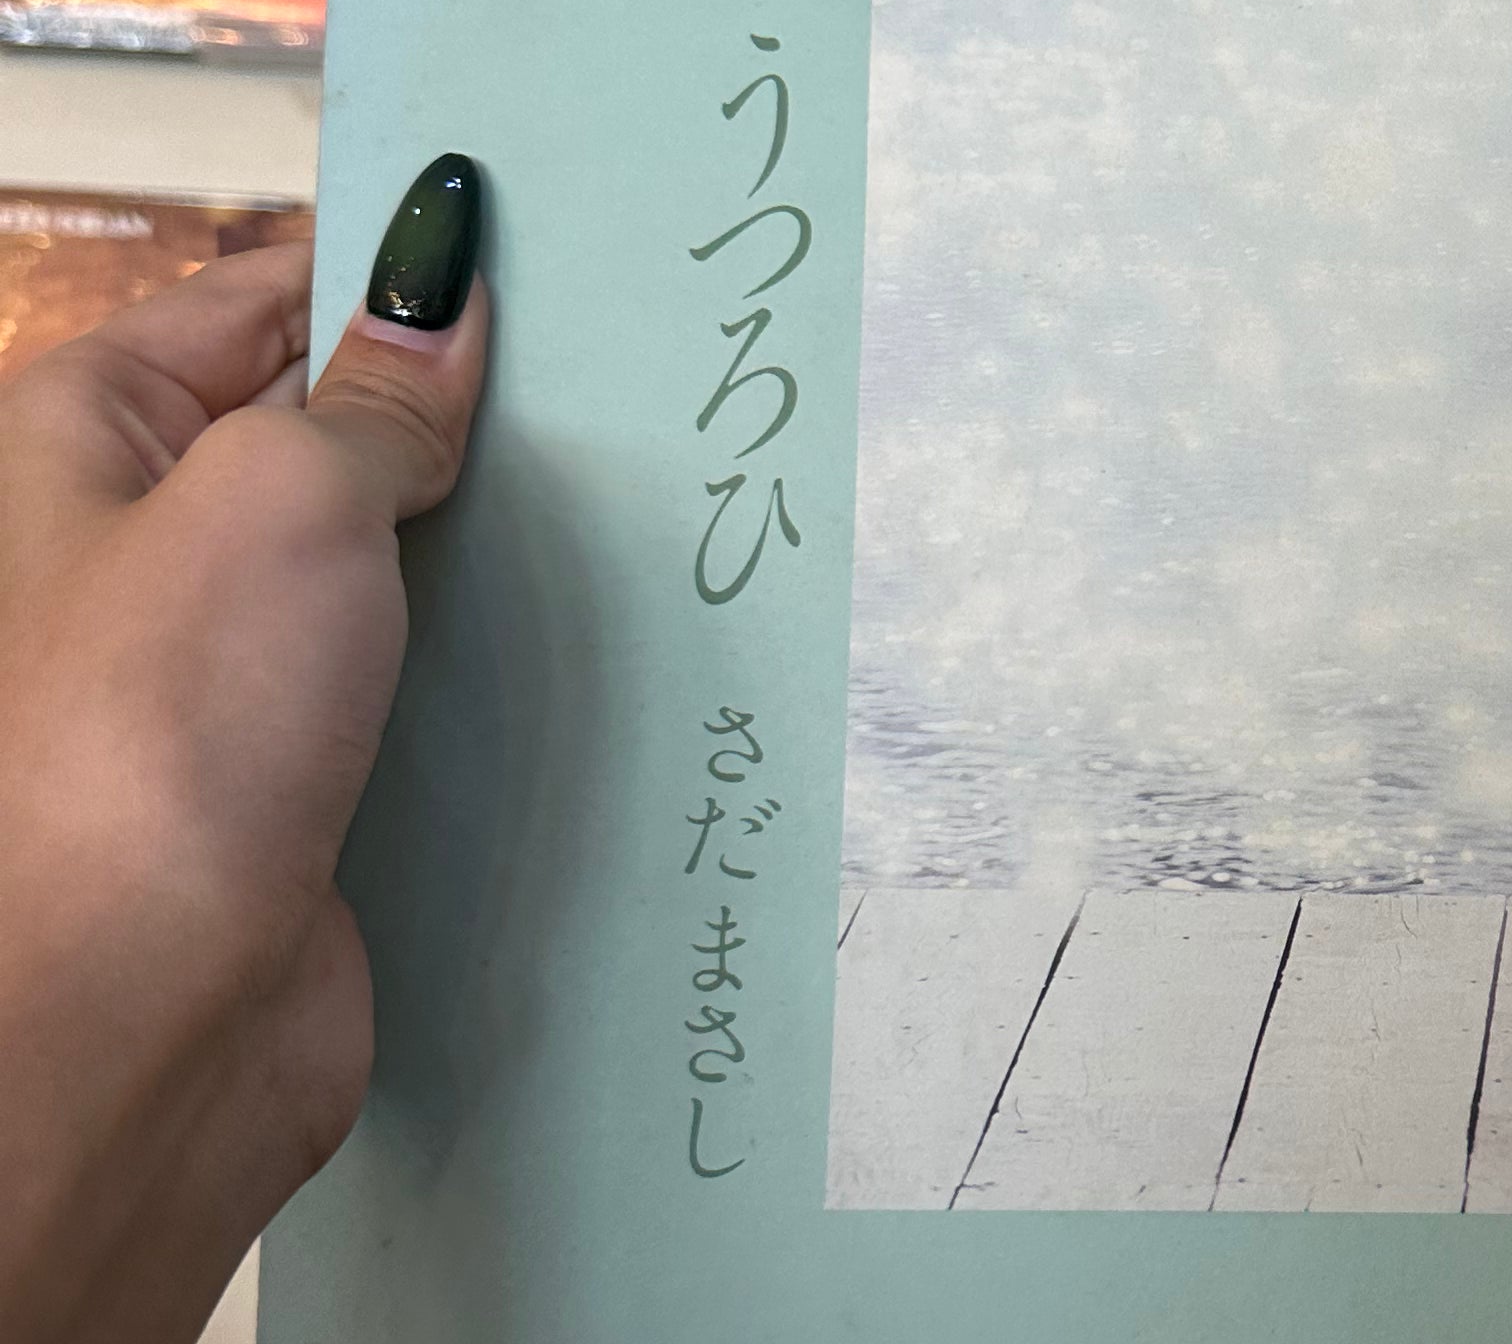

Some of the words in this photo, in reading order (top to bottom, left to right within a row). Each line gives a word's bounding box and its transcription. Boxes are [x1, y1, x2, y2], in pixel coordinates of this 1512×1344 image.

[689, 33, 812, 605] うつろひ
[684, 705, 782, 1179] さだまさし
